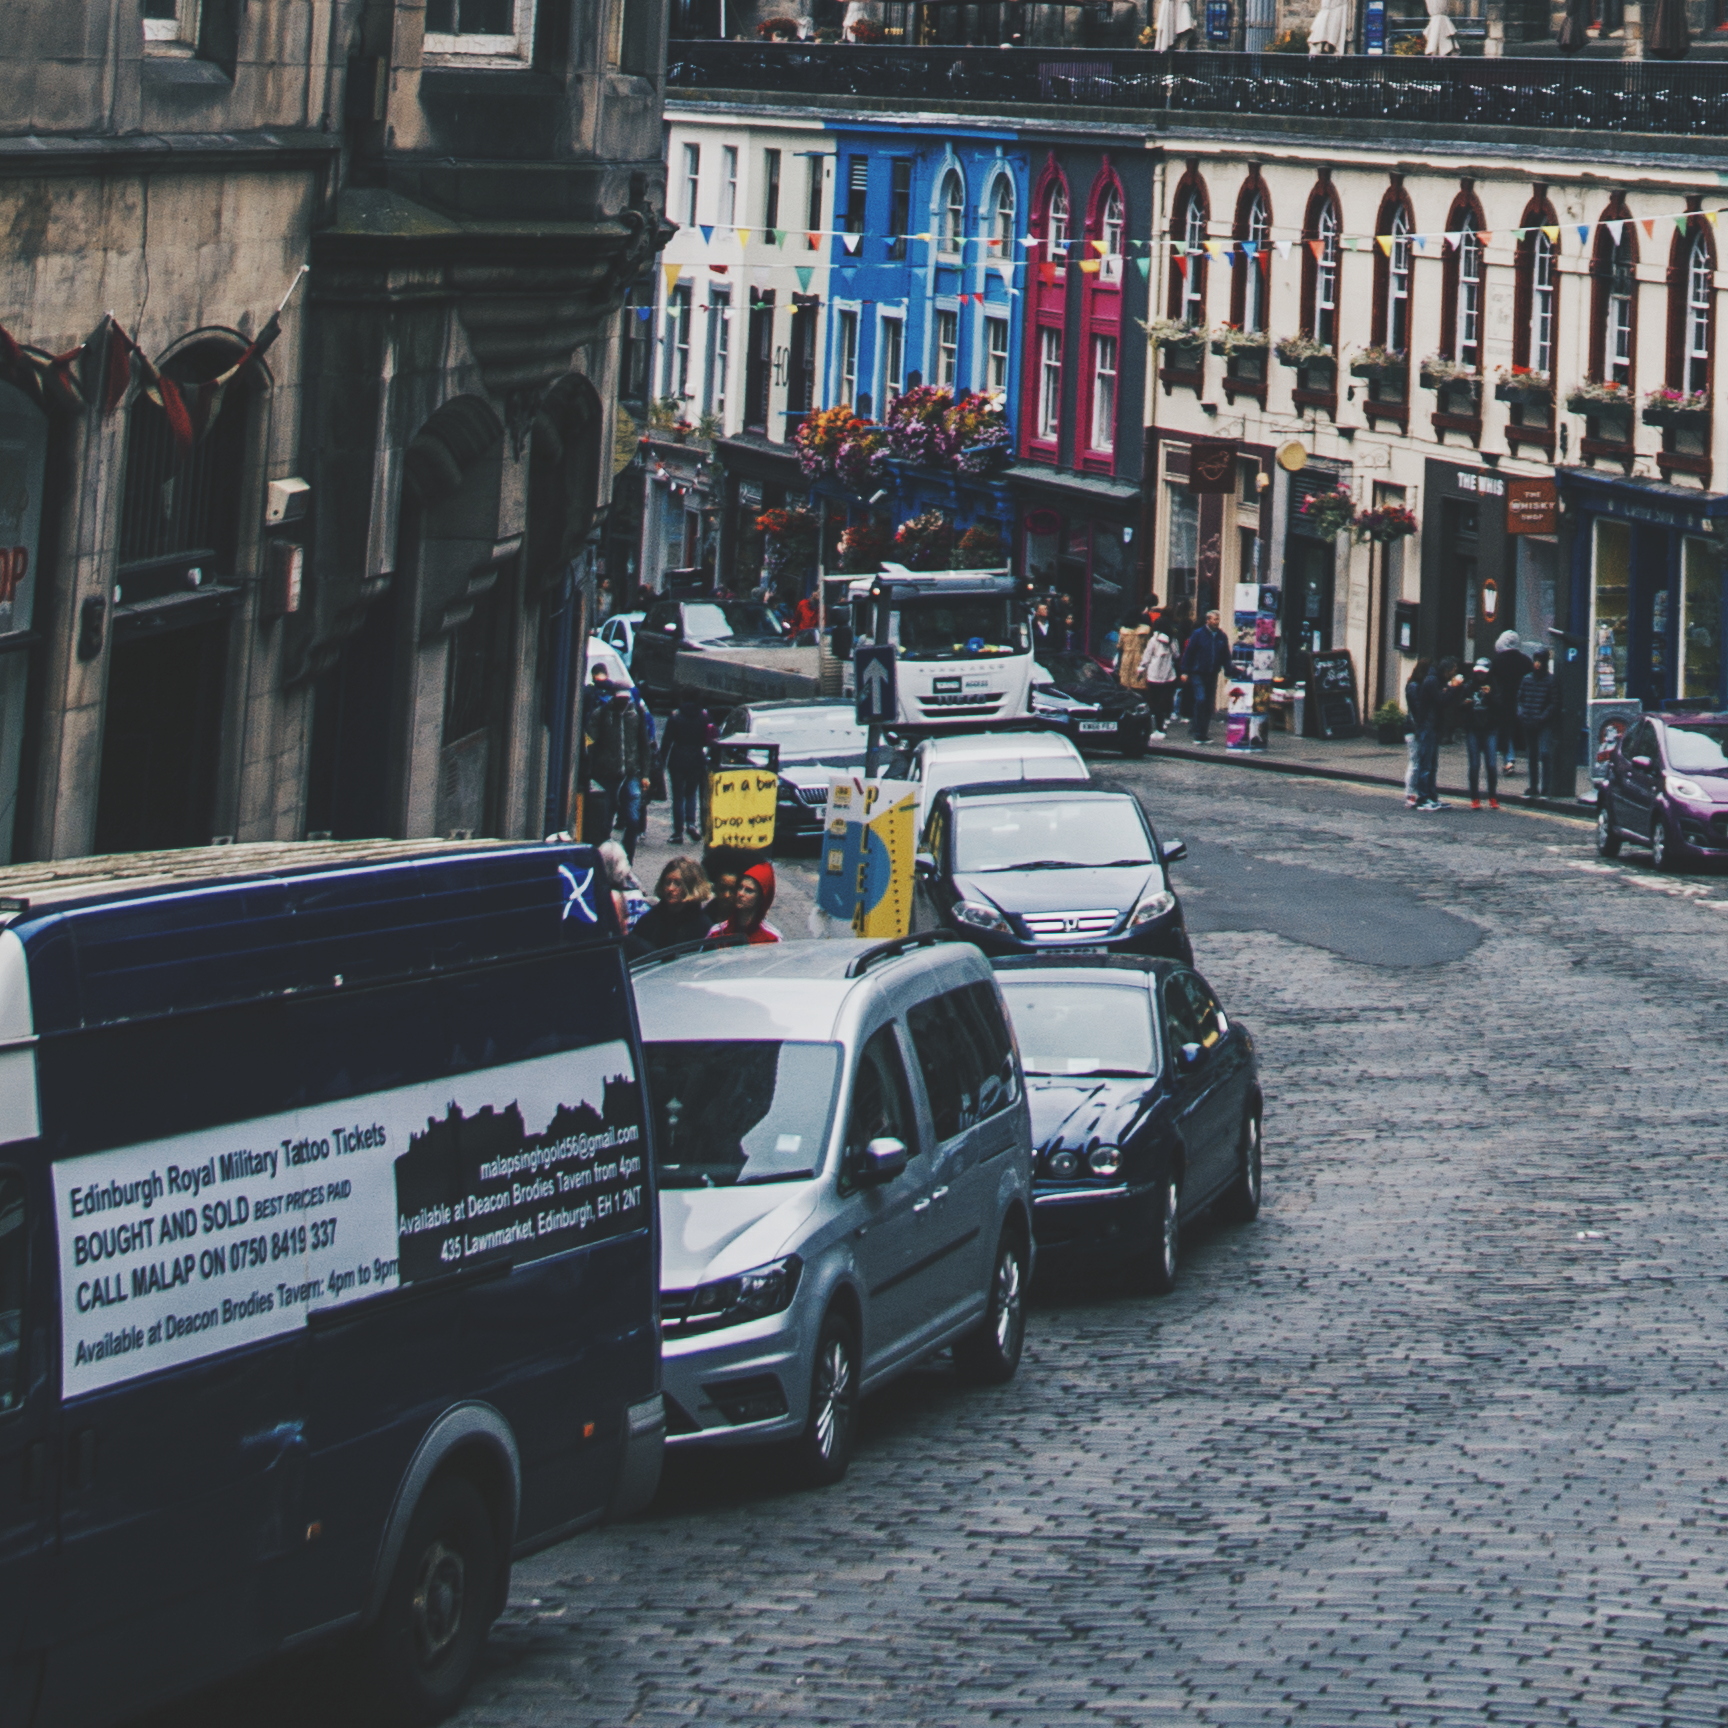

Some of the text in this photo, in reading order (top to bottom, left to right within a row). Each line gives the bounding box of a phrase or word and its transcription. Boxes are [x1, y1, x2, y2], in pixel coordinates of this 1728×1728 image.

[1457, 471, 1504, 496] THE WHIS
[1511, 500, 1556, 512] WHISKY
[741, 779, 750, 791] a
[756, 775, 777, 792] bin
[70, 1121, 386, 1219] Edinburgh Royal Military Tattoo Tickets
[400, 1156, 640, 1237] Available at Deacon Brodies Tavern from 4pm
[75, 1179, 352, 1266] BOUGHT AND SOLD BEST PRICES PAID
[441, 1236, 461, 1262] 435
[464, 1218, 535, 1257] Lawnmarket,
[538, 1201, 596, 1236] Edinburgh,
[597, 1195, 612, 1217] EH
[623, 1185, 642, 1210] 2NT
[77, 1217, 337, 1314] CALL MALAP ON 0750 8419 337
[75, 1257, 400, 1367] Available at Deacon Brodies Tavern: 4pm to 9pm
